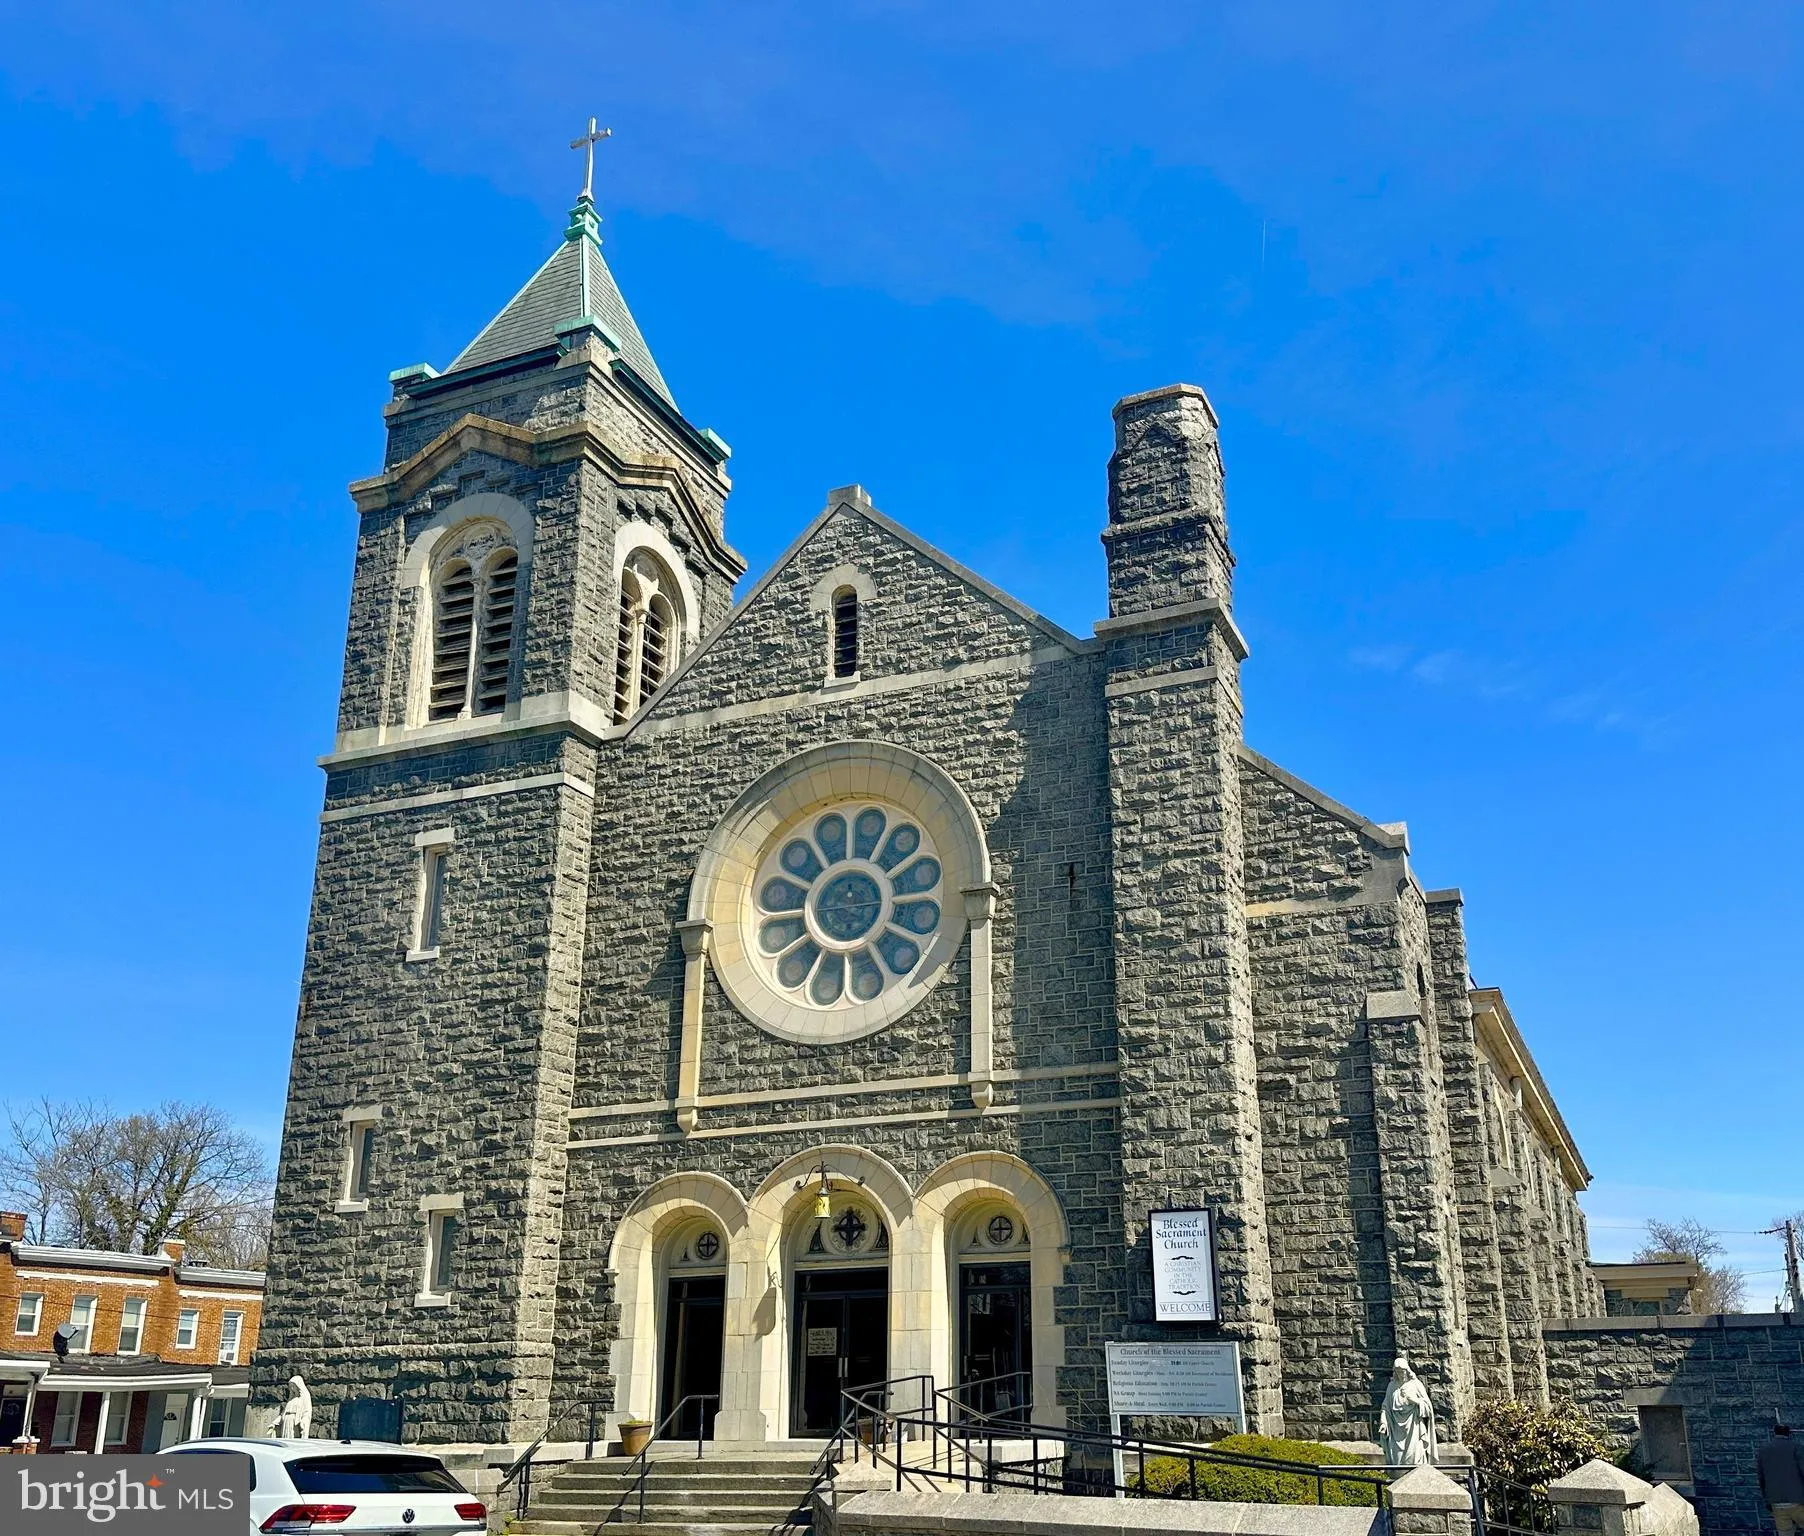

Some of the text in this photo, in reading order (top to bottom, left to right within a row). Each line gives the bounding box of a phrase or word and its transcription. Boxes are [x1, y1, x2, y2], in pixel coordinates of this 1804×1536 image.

[1163, 1217, 1199, 1229] Blessed
[1156, 1228, 1207, 1239] Sacrament
[1164, 1238, 1199, 1249] Church
[1160, 1303, 1211, 1313] WELCOME
